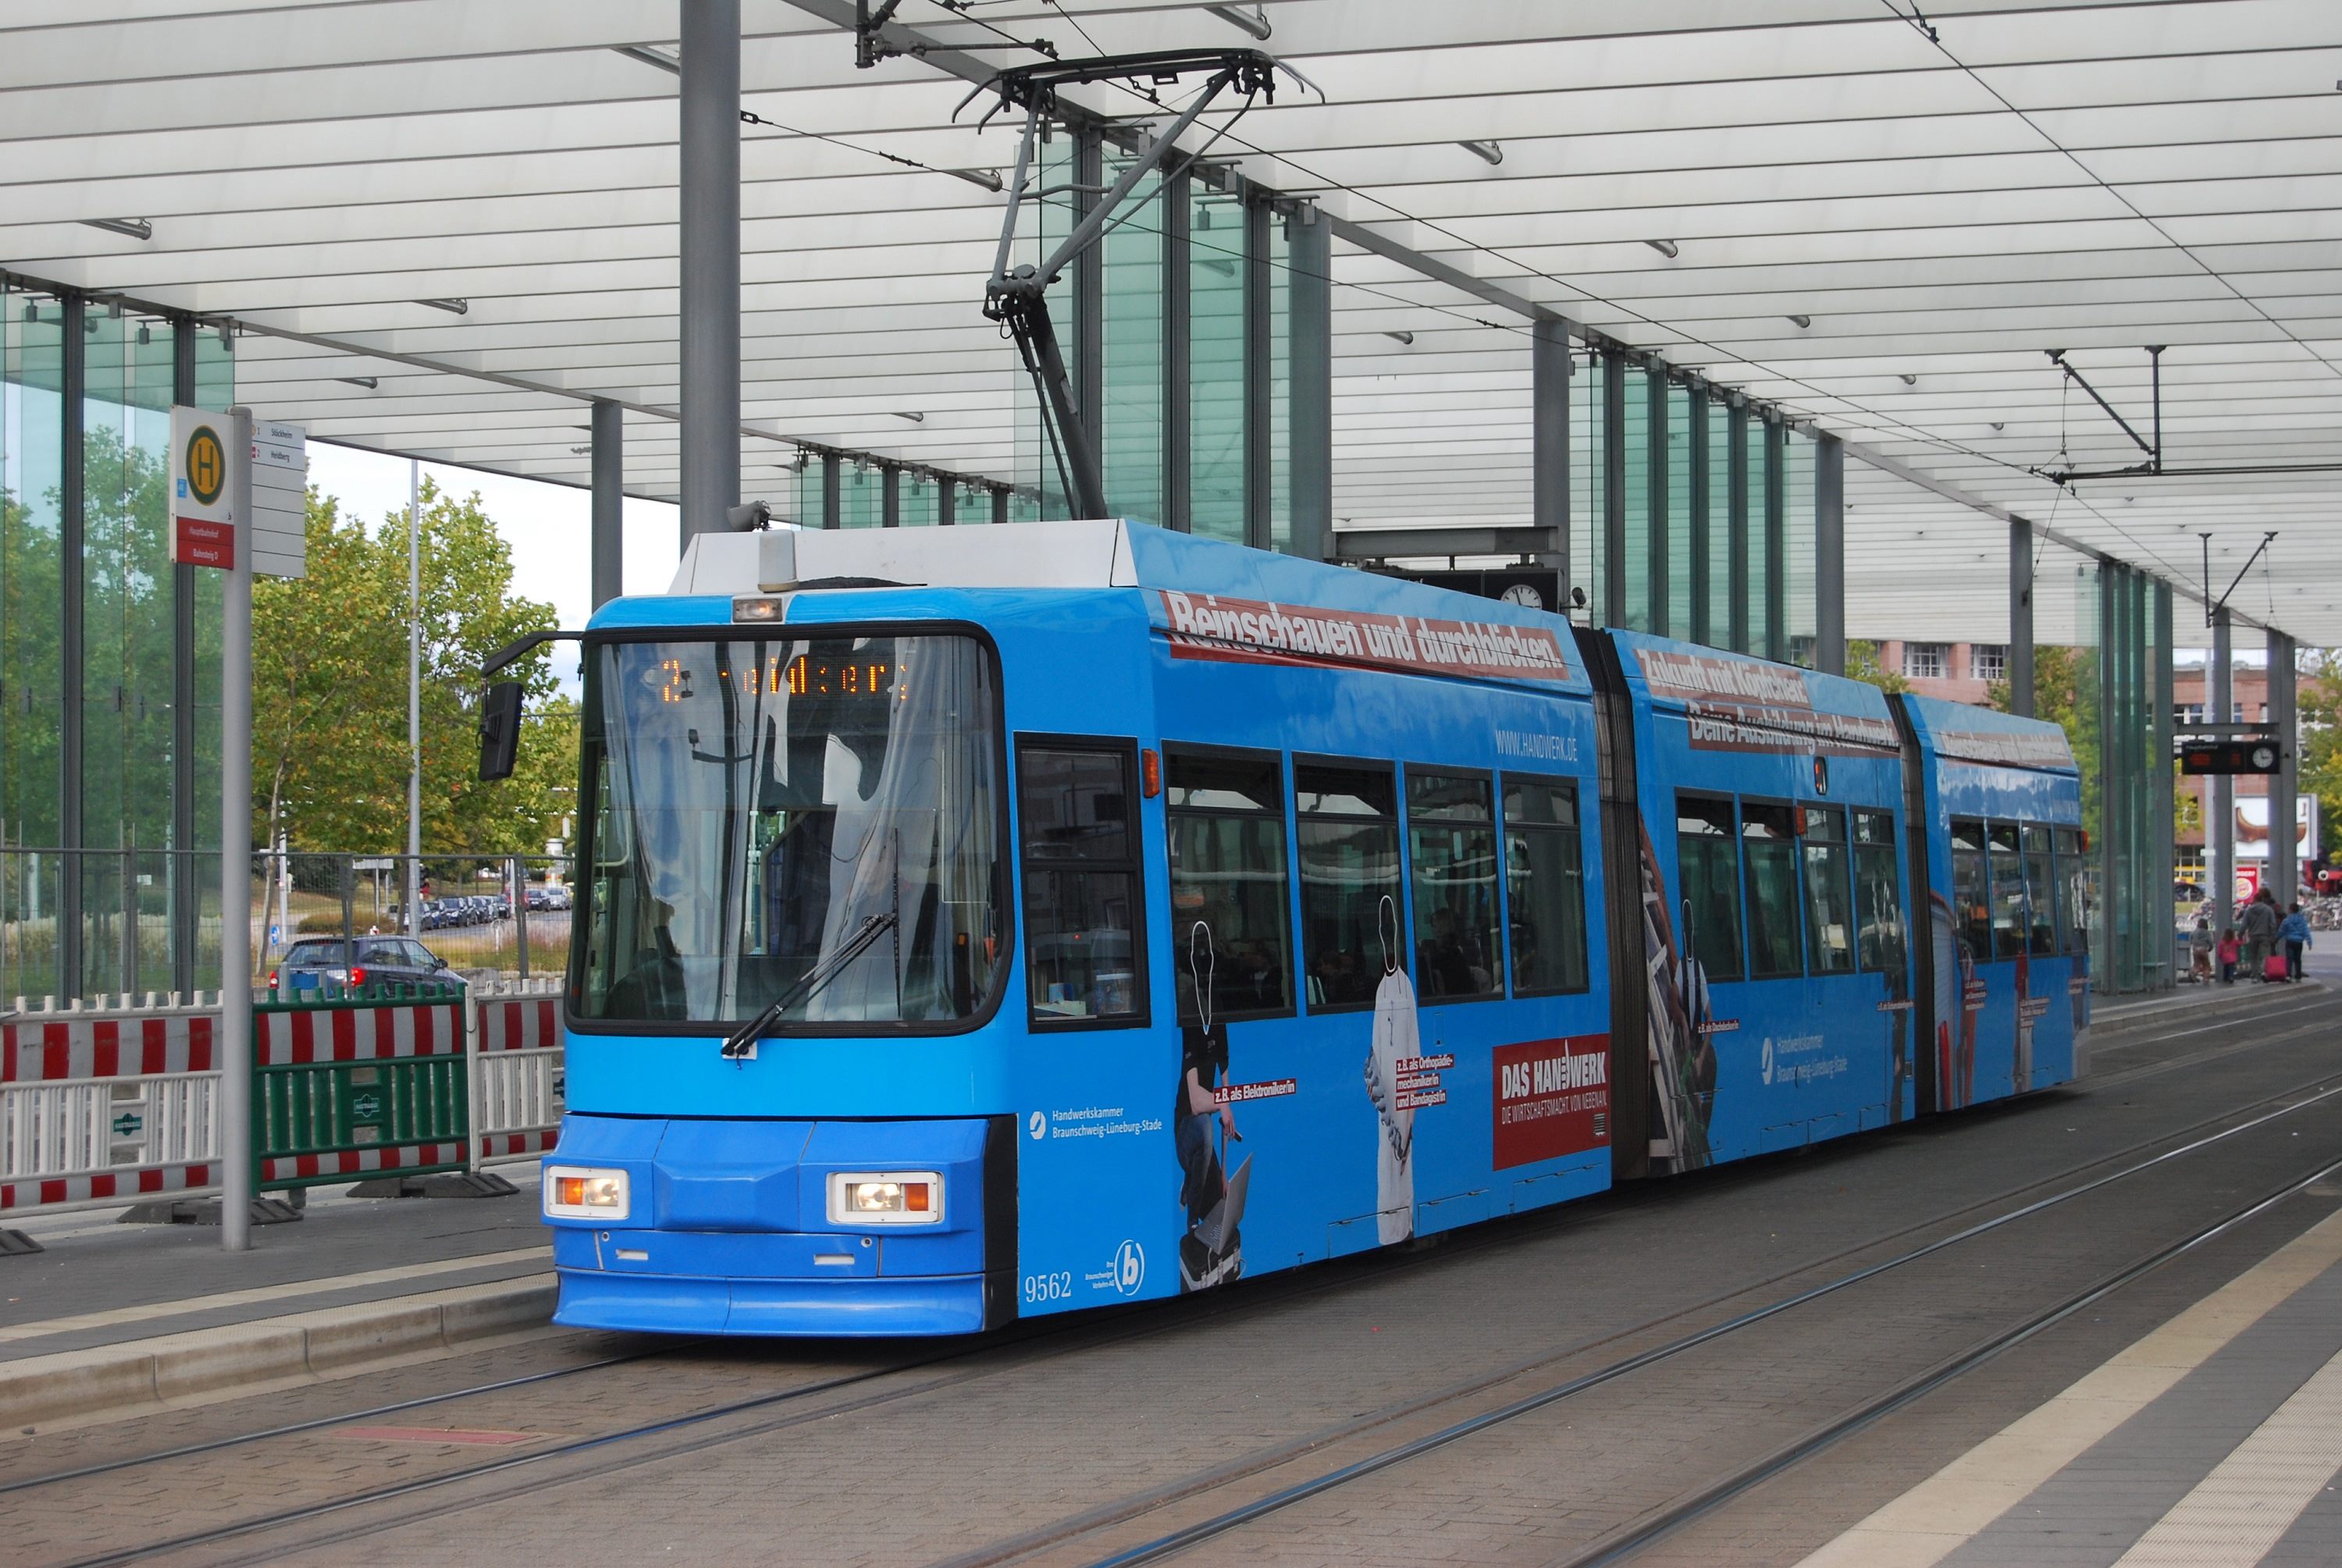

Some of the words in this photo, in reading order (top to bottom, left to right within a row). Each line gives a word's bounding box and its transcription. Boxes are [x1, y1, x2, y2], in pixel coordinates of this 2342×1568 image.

[198, 443, 215, 489] H
[1166, 589, 1365, 657] Reinschauen
[1361, 614, 1418, 662] und
[1415, 616, 1563, 669] durchblicken.
[663, 659, 680, 702] 2
[1637, 649, 1709, 692] Zukunft
[1707, 659, 1739, 695] mit
[1687, 701, 1736, 744] Deine
[1735, 706, 1816, 756] Ausbildung
[1813, 713, 1835, 748] im
[1495, 730, 1578, 762] WWW.HANDWERK.DE
[1408, 1058, 1419, 1071] als
[1418, 1054, 1453, 1070] Orthopädie-
[1215, 1087, 1230, 1104] z.B.
[1230, 1086, 1243, 1101] als
[1501, 1061, 1530, 1100] DAS
[1052, 1106, 1124, 1122] Handwerkskammer
[1397, 1093, 1409, 1108] und
[1501, 1106, 1511, 1125] DIE
[1570, 1094, 1582, 1112] VON
[1052, 1118, 1163, 1139] Braunschweig-Lüneburg-Stade
[1025, 1271, 1072, 1303] 9562
